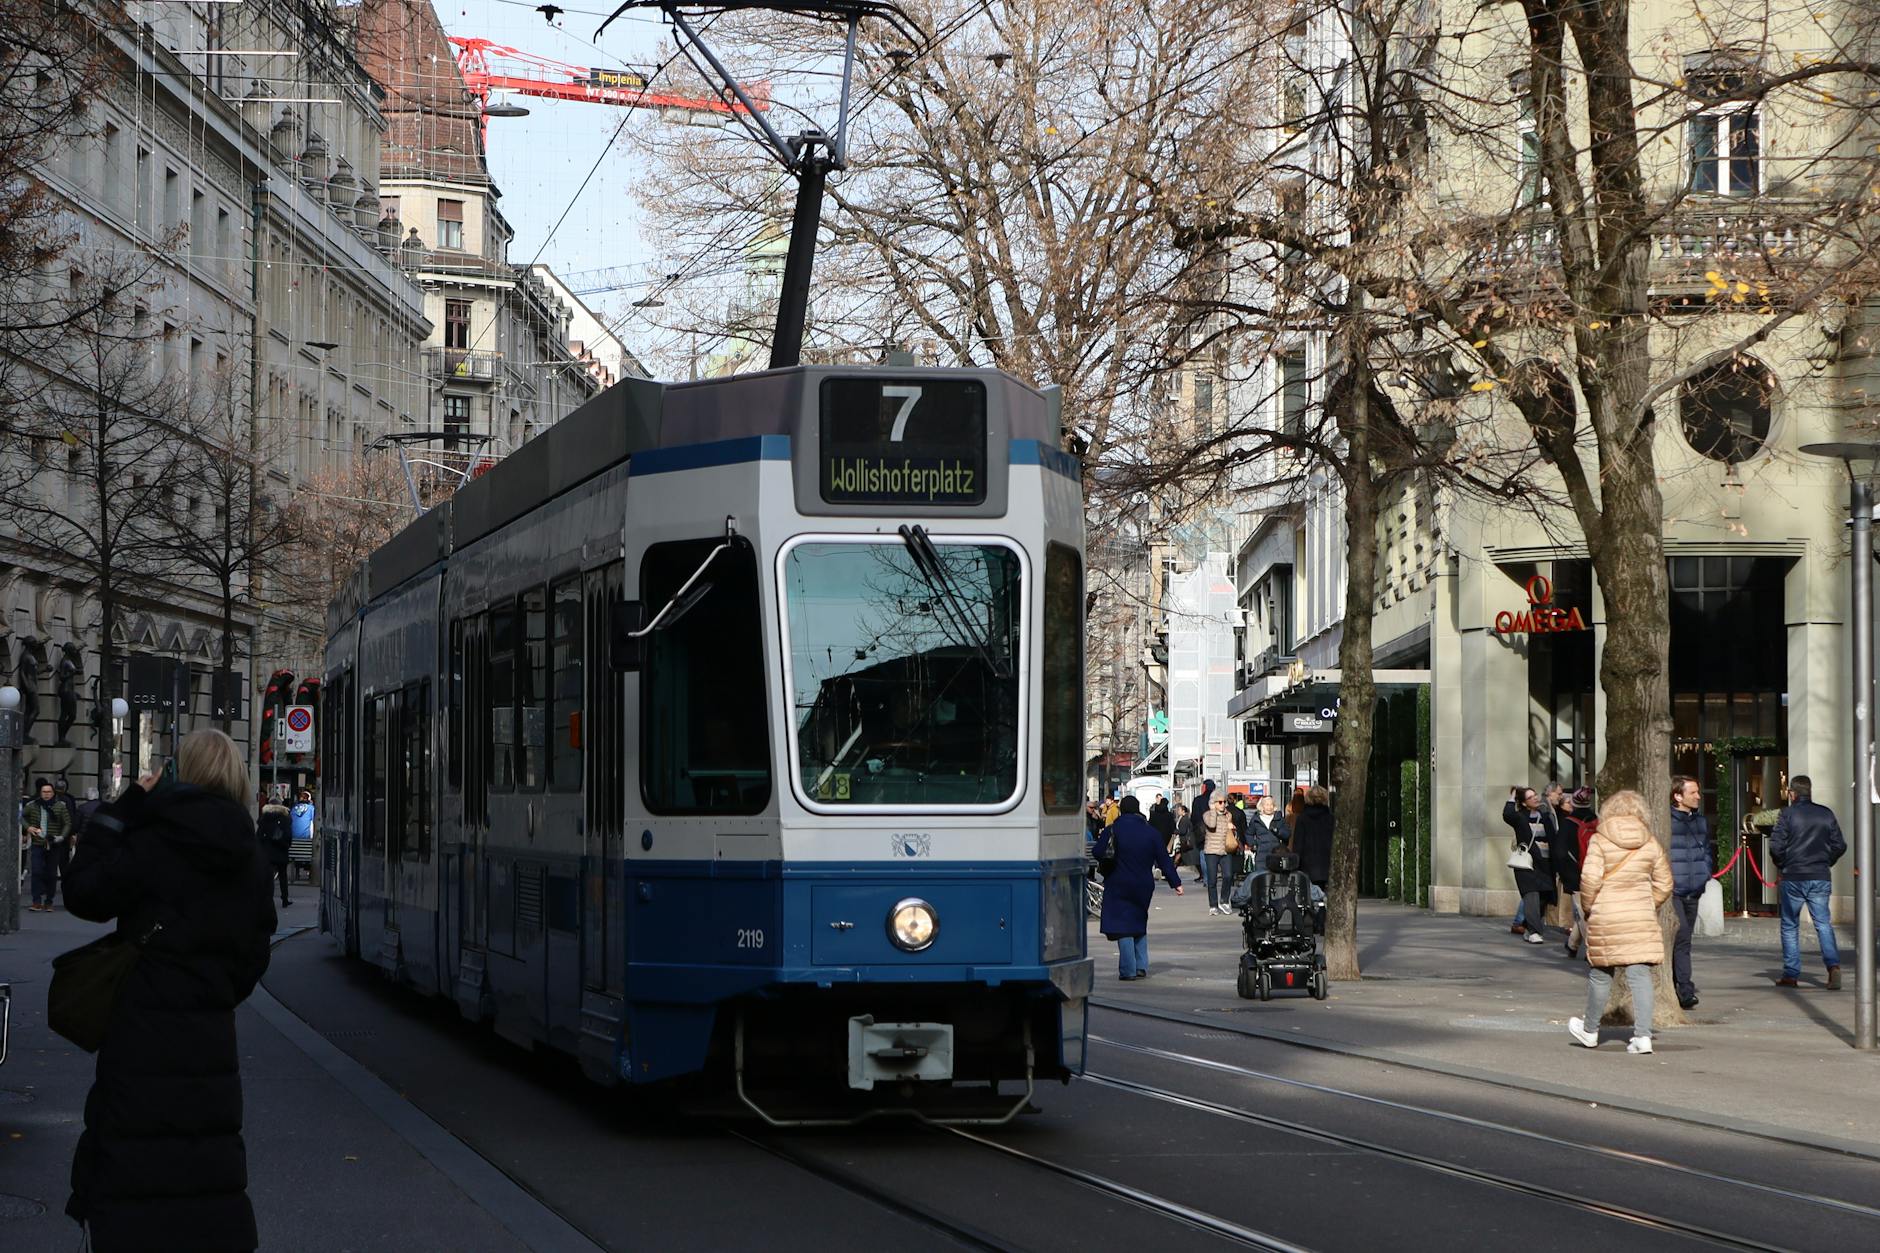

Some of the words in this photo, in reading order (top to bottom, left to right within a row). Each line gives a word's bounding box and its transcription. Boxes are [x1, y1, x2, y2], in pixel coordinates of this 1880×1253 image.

[599, 72, 642, 86] Impenia
[602, 90, 618, 98] 300
[882, 386, 922, 442] 7
[831, 458, 975, 501] Wollishoferplatz
[1496, 607, 1585, 633] OMEGA
[134, 694, 156, 704] COS
[737, 928, 764, 949] 2119
